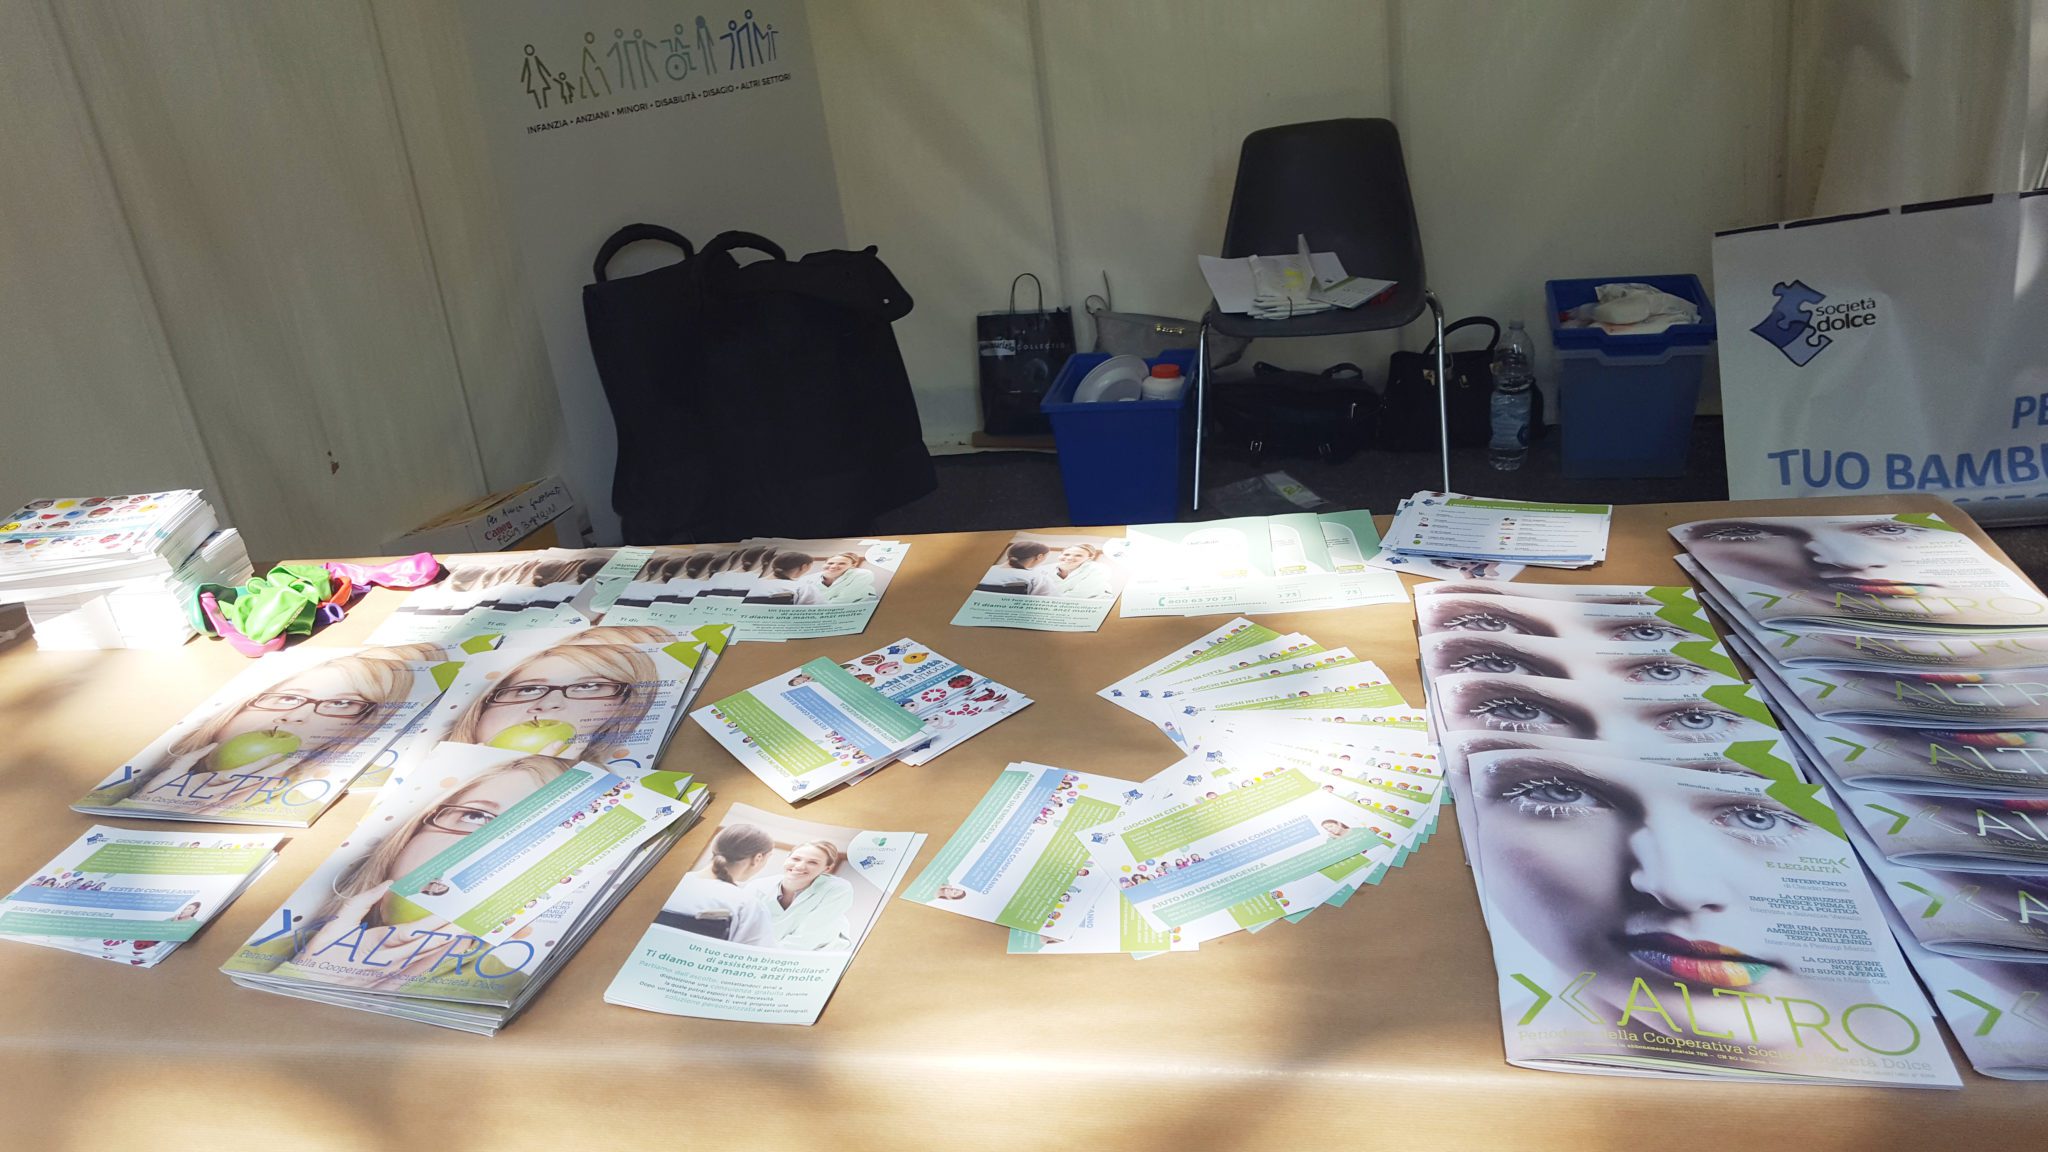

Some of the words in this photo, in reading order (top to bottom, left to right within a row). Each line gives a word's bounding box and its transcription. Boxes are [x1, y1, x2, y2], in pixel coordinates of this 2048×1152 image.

[527, 119, 568, 134] INFANZIA
[575, 110, 610, 125] ANZIANI
[616, 103, 649, 116] MINORI
[655, 91, 697, 108] DISABILITÀ
[702, 85, 734, 98] DISAGIO
[740, 80, 759, 91] ALTRI
[761, 72, 791, 87] SETTORI
[1816, 297, 1876, 316] società
[1816, 312, 1876, 332] dolce
[1767, 448, 1870, 490] TUO
[484, 520, 513, 541] Canon
[147, 771, 331, 808] ALTRO
[1123, 817, 1153, 832] GIOCHI
[1164, 803, 1189, 816] CITTÀ
[1209, 842, 1237, 857] FESTE
[1238, 837, 1248, 846] DI
[1248, 814, 1309, 843] COMPLEANNO
[1778, 862, 1842, 874] LEGALITÀ
[1799, 856, 1837, 865] ETICA
[1151, 896, 1180, 911] AIUTO
[1181, 890, 1196, 901] HO
[1196, 862, 1268, 895] UN'EMERGENZA
[1776, 923, 1795, 931] PER
[1796, 924, 1819, 932] UNA
[1785, 934, 1816, 942] TERZO
[320, 921, 535, 980] ALTRO
[689, 943, 702, 953] Un
[704, 947, 721, 957] tuo
[723, 951, 744, 961] caro
[747, 955, 758, 963] ha
[760, 957, 800, 969] bisogno
[318, 961, 384, 978] Cooperativa
[645, 949, 656, 957] Ti
[658, 952, 695, 968] diamo
[698, 963, 718, 973] una
[721, 968, 757, 980] mano,
[760, 973, 784, 981] anzi
[786, 974, 825, 982] molte.
[706, 956, 715, 964] di
[717, 959, 768, 972] assistenza
[770, 964, 830, 975] domiciliare?
[659, 973, 696, 986] disposizione
[1617, 976, 1921, 1057] ALTRO
[1643, 1031, 1744, 1055] Cooperativa
[1882, 1056, 1933, 1072] Dolce
